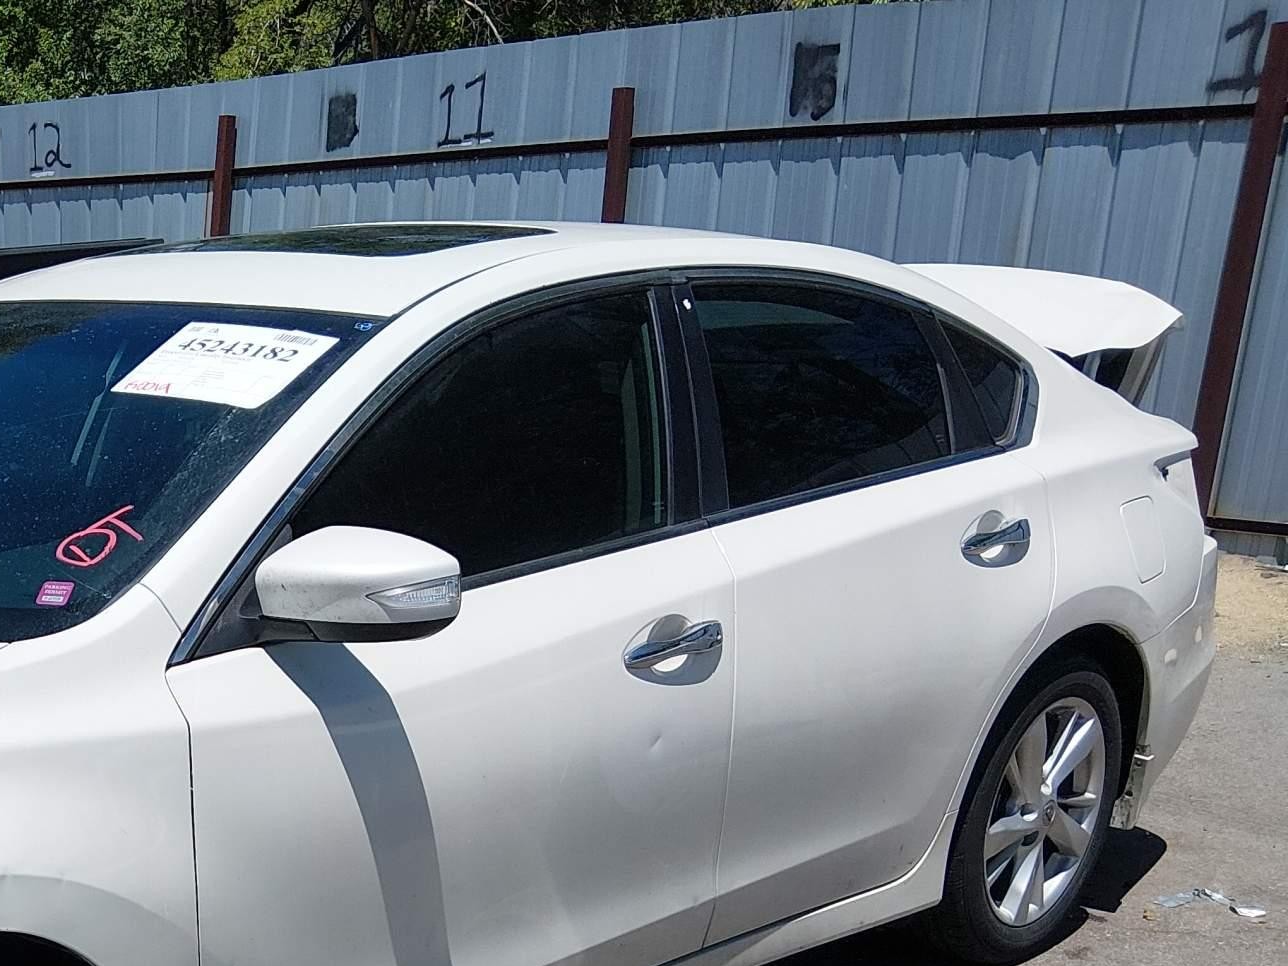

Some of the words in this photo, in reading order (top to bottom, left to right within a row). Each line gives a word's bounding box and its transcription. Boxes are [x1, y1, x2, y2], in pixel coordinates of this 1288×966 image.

[437, 70, 494, 147] 11
[28, 122, 72, 172] 12
[178, 336, 300, 363] 45243182
